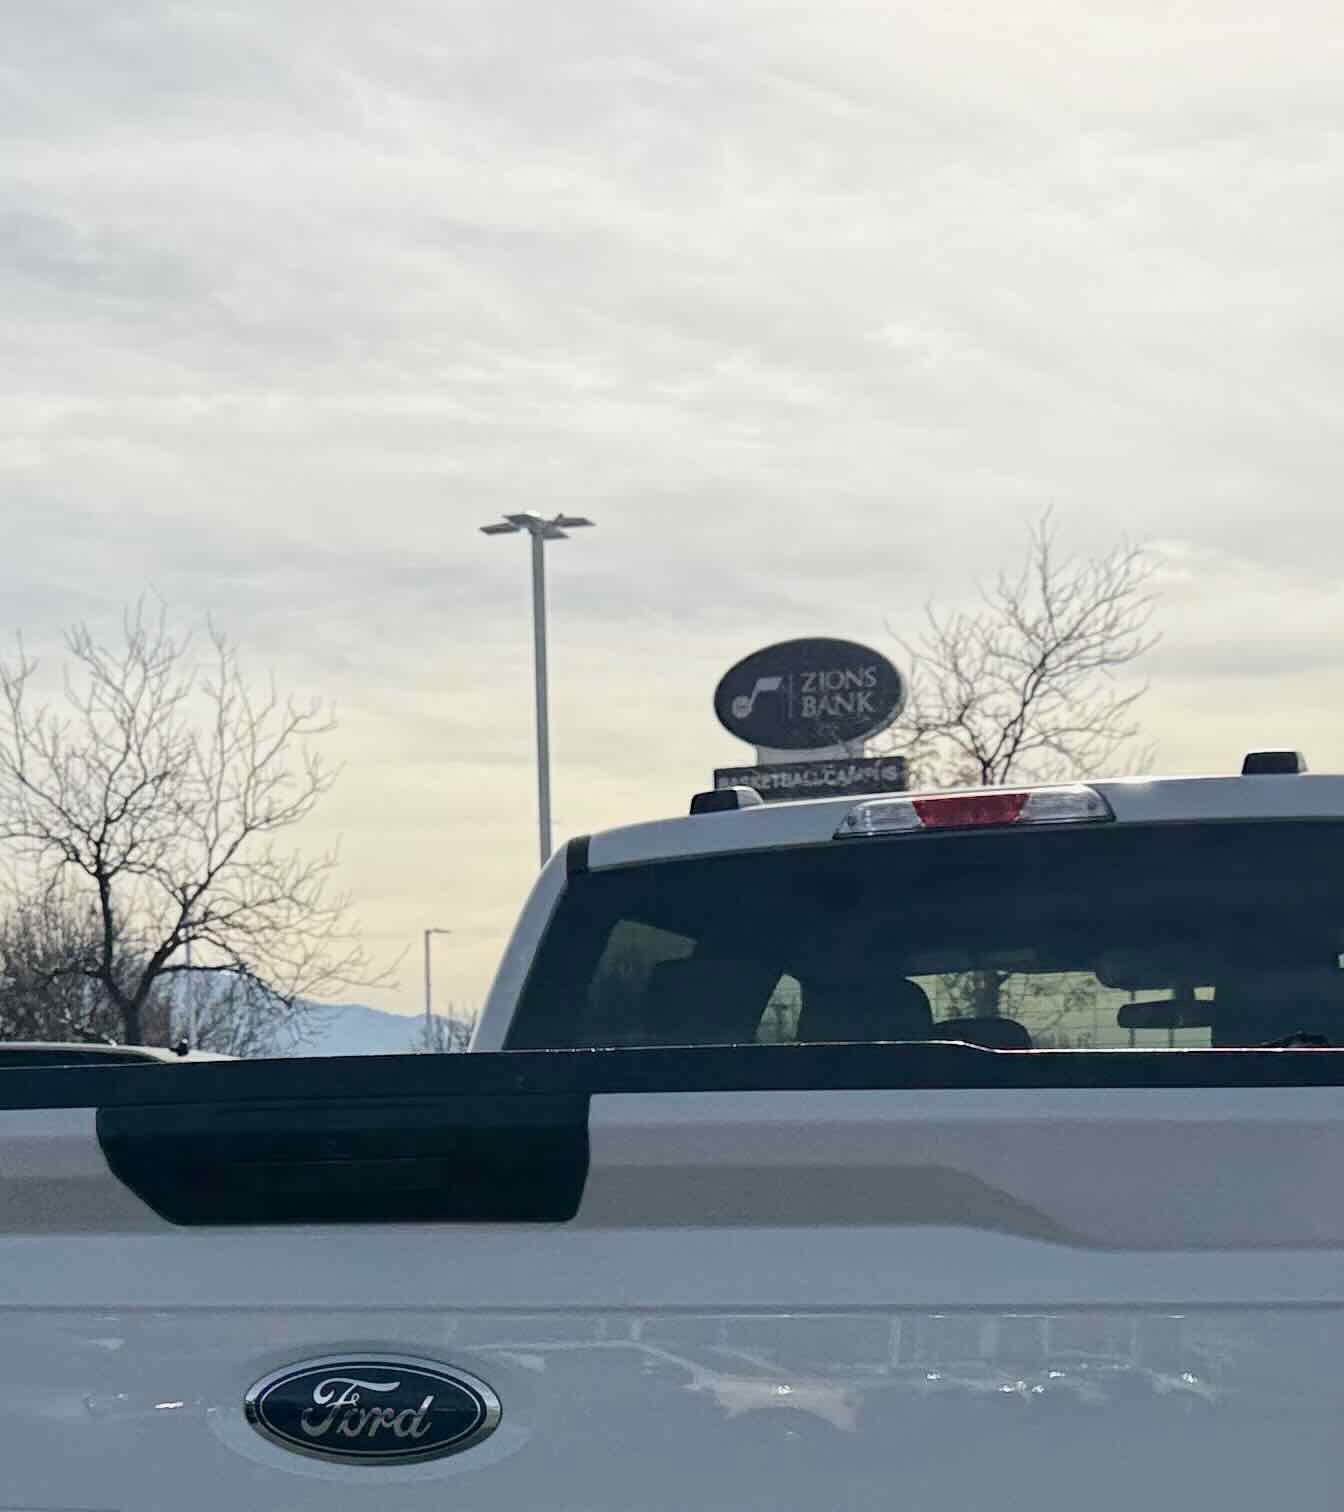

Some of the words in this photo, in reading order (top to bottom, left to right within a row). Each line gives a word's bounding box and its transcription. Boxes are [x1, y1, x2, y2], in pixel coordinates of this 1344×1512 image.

[799, 664, 877, 693] ZIONS
[800, 691, 875, 719] BANK
[301, 1376, 434, 1439] Ford
